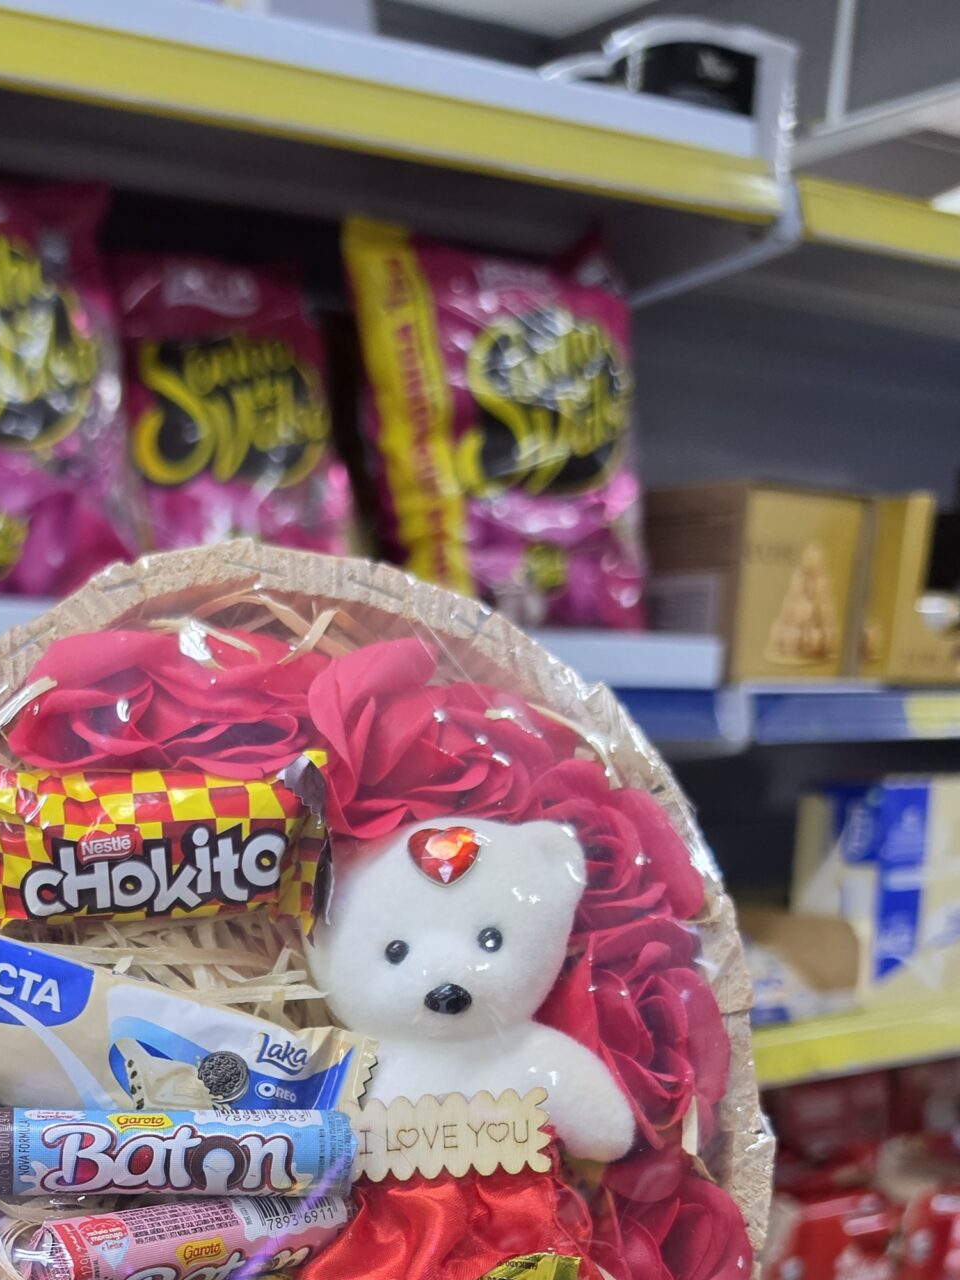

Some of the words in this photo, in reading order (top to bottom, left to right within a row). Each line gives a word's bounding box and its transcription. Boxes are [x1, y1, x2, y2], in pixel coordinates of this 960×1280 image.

[81, 834, 131, 858] Nestlé
[257, 1032, 309, 1077] Laka
[255, 1081, 297, 1103] OREO
[116, 1114, 164, 1129] Garoto
[385, 1122, 456, 1152] LOVE
[471, 1119, 530, 1144] YOU
[18, 1155, 30, 1175] NOVA
[42, 1122, 297, 1191] Baton
